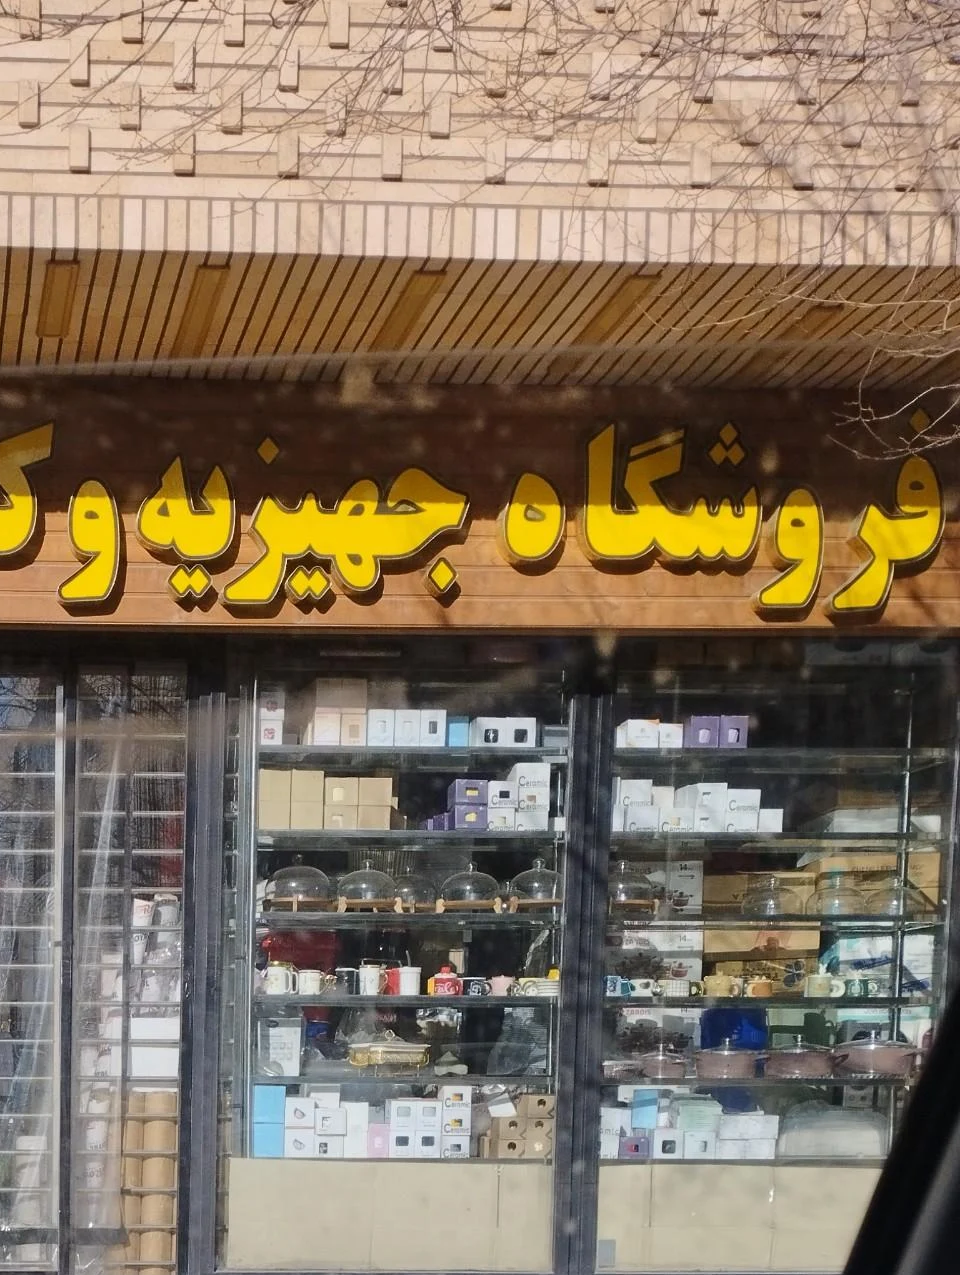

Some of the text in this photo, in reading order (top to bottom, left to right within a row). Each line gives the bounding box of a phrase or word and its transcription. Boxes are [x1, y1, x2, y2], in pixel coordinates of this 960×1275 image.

[57, 478, 121, 604] و
[135, 435, 471, 606] جهیزیه
[501, 407, 946, 613] فروشگاه
